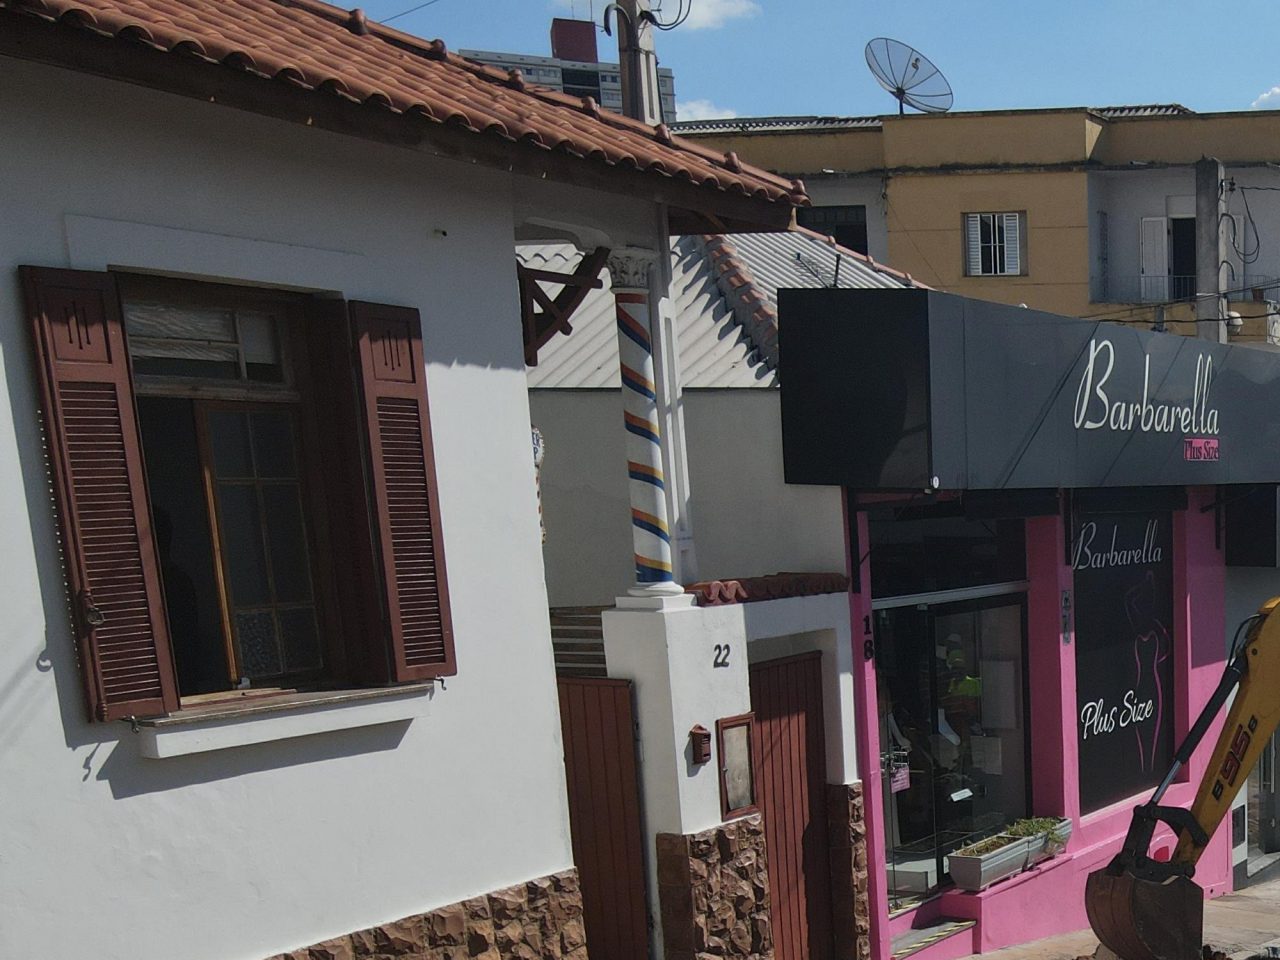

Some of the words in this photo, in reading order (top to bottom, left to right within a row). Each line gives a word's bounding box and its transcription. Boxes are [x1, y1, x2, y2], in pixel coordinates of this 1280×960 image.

[1074, 339, 1220, 435] Barbarella
[1184, 440, 1203, 460] Plus
[1203, 440, 1219, 460] Size
[1072, 519, 1163, 570] Barbarella
[713, 643, 731, 669] 22
[1080, 698, 1118, 740] Plus
[1119, 690, 1153, 727] Size
